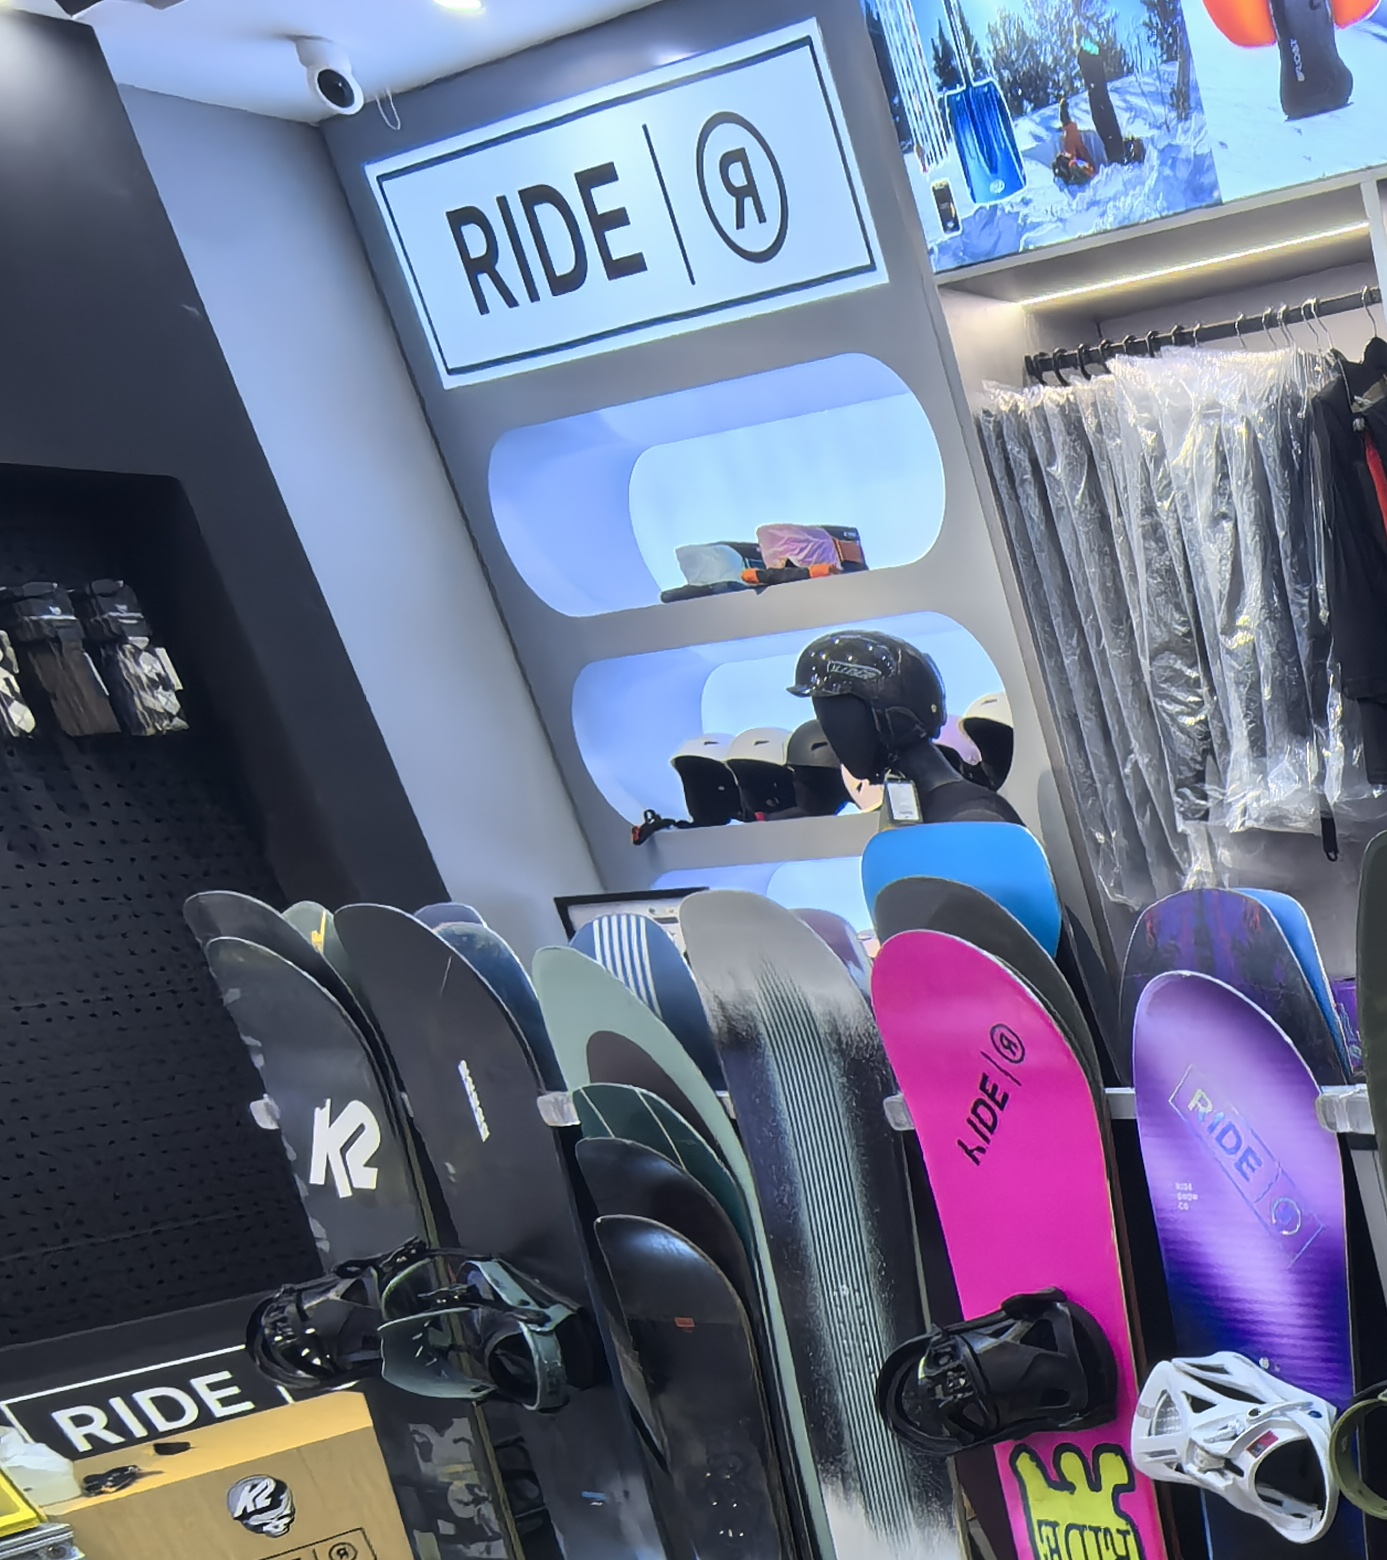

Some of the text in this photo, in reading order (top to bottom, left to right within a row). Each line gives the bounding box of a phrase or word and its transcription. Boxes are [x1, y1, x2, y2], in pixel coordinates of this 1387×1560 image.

[446, 162, 647, 315] RIDE
[309, 1098, 381, 1198] K2
[1187, 1088, 1263, 1183] RIDE
[51, 1370, 255, 1453] RIDE
